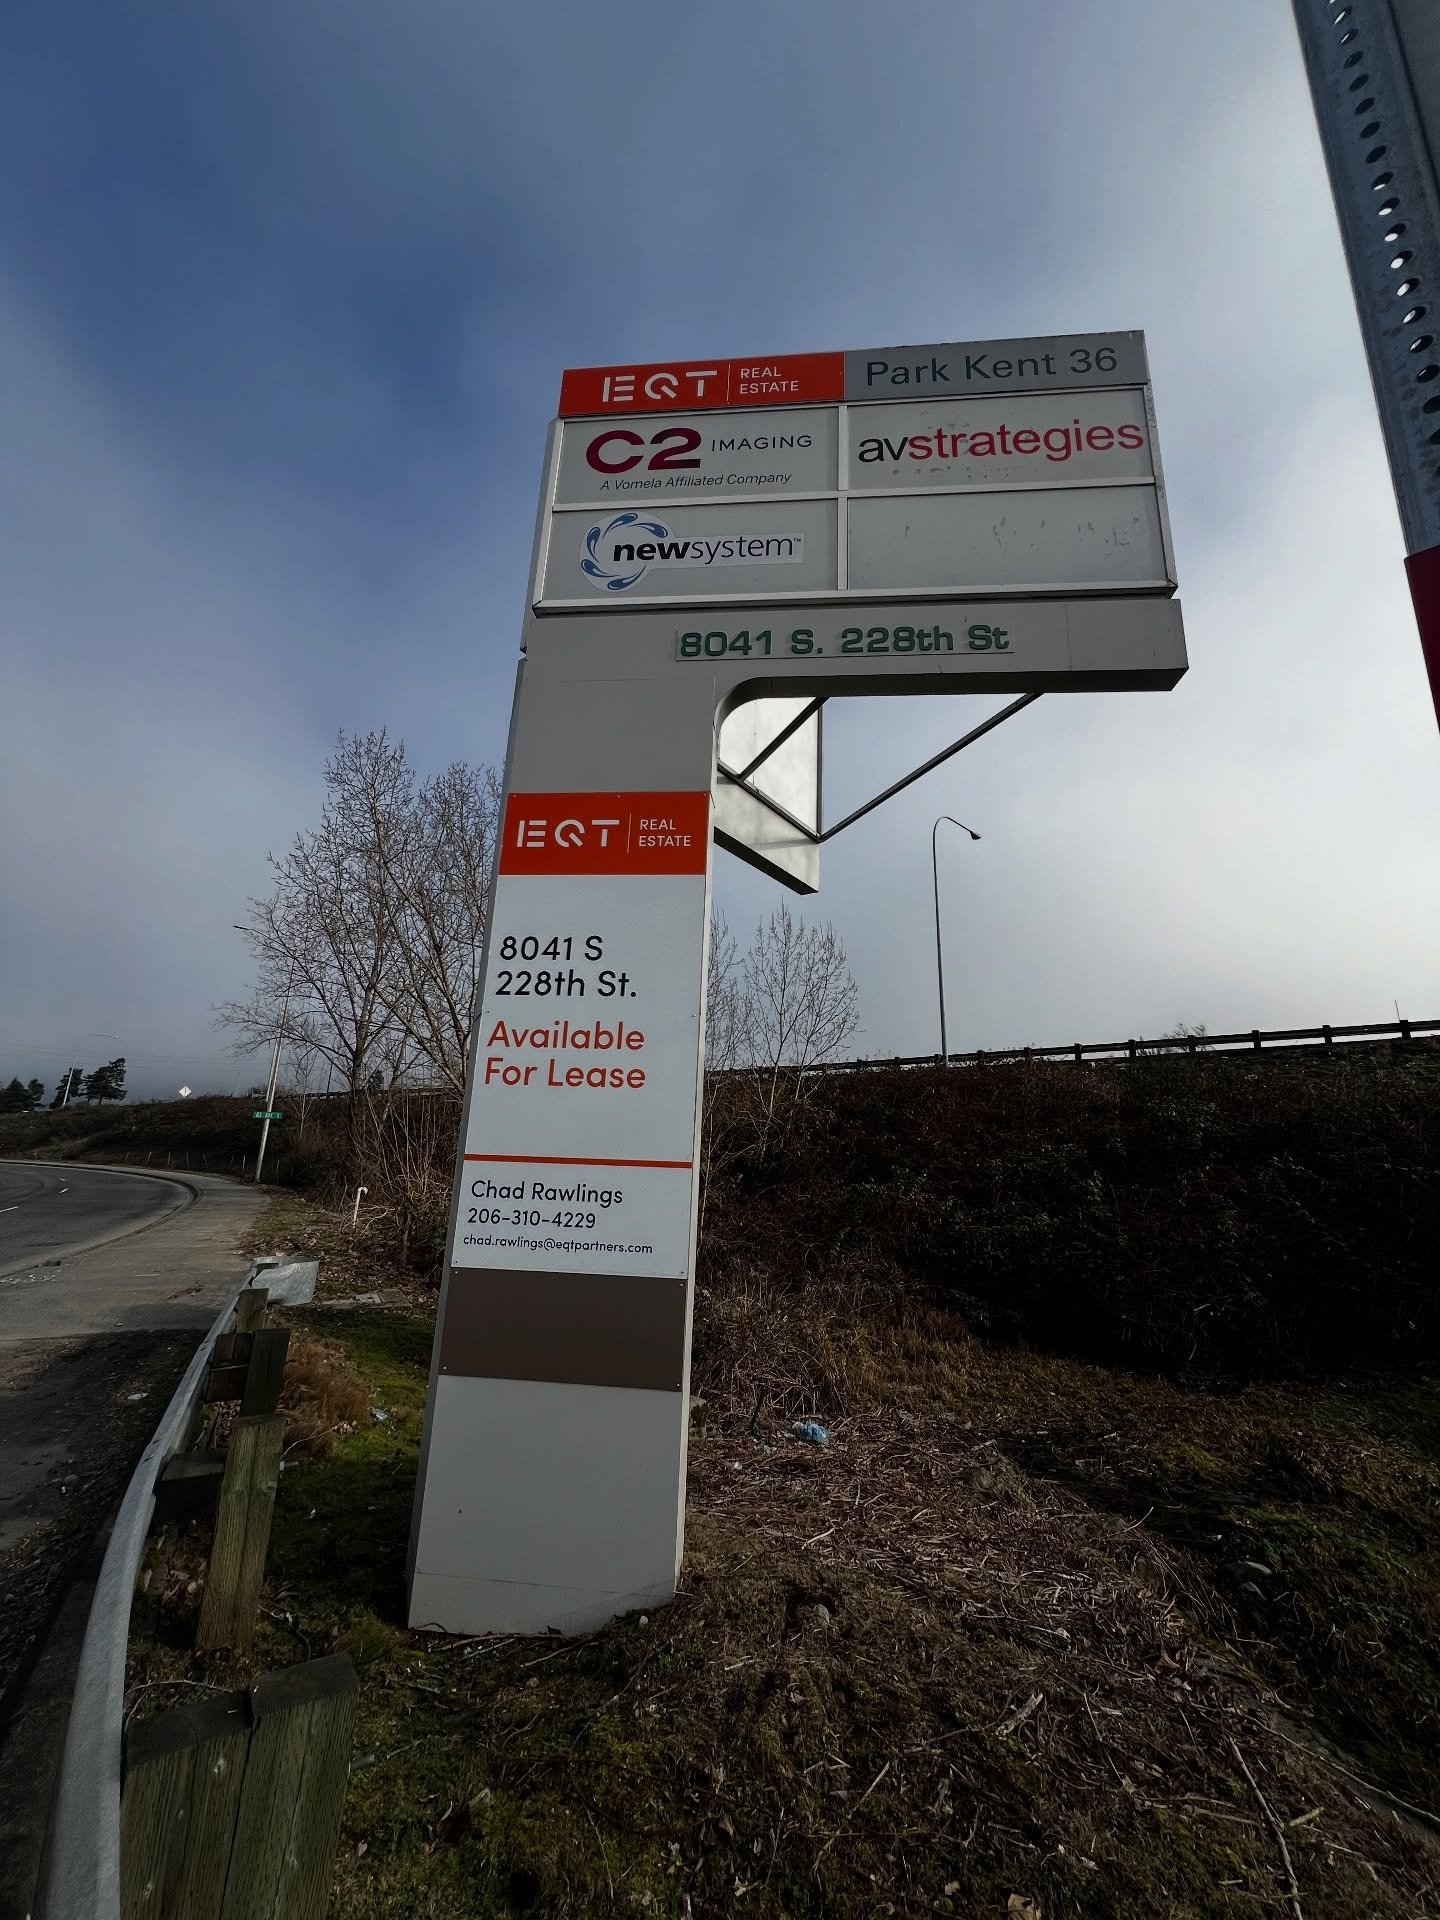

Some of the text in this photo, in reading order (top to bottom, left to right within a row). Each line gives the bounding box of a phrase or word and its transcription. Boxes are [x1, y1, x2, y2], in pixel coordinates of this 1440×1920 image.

[740, 366, 782, 379] REAL
[866, 347, 1118, 386] Park Kent 36
[602, 370, 718, 402] EQT
[739, 380, 799, 394] ESTATE
[585, 427, 702, 474] C2
[711, 435, 812, 452] IMAGING
[858, 419, 1144, 463] avstrategies
[600, 472, 792, 491] A Vomela Affiliated Company
[680, 624, 1010, 657] 8041 S. 228th St
[516, 819, 620, 848] EQT
[640, 819, 677, 830] REAL
[638, 835, 692, 847] ESTATE
[499, 935, 604, 961] 8041 S
[495, 969, 637, 998] 228th St.
[487, 1020, 645, 1050] Available
[485, 1057, 646, 1089] For Lease
[471, 1179, 623, 1208] Chad Rawlings
[467, 1207, 597, 1229] 206-310-4229
[463, 1235, 653, 1254] chad.rawlings@eqtpartners.com
